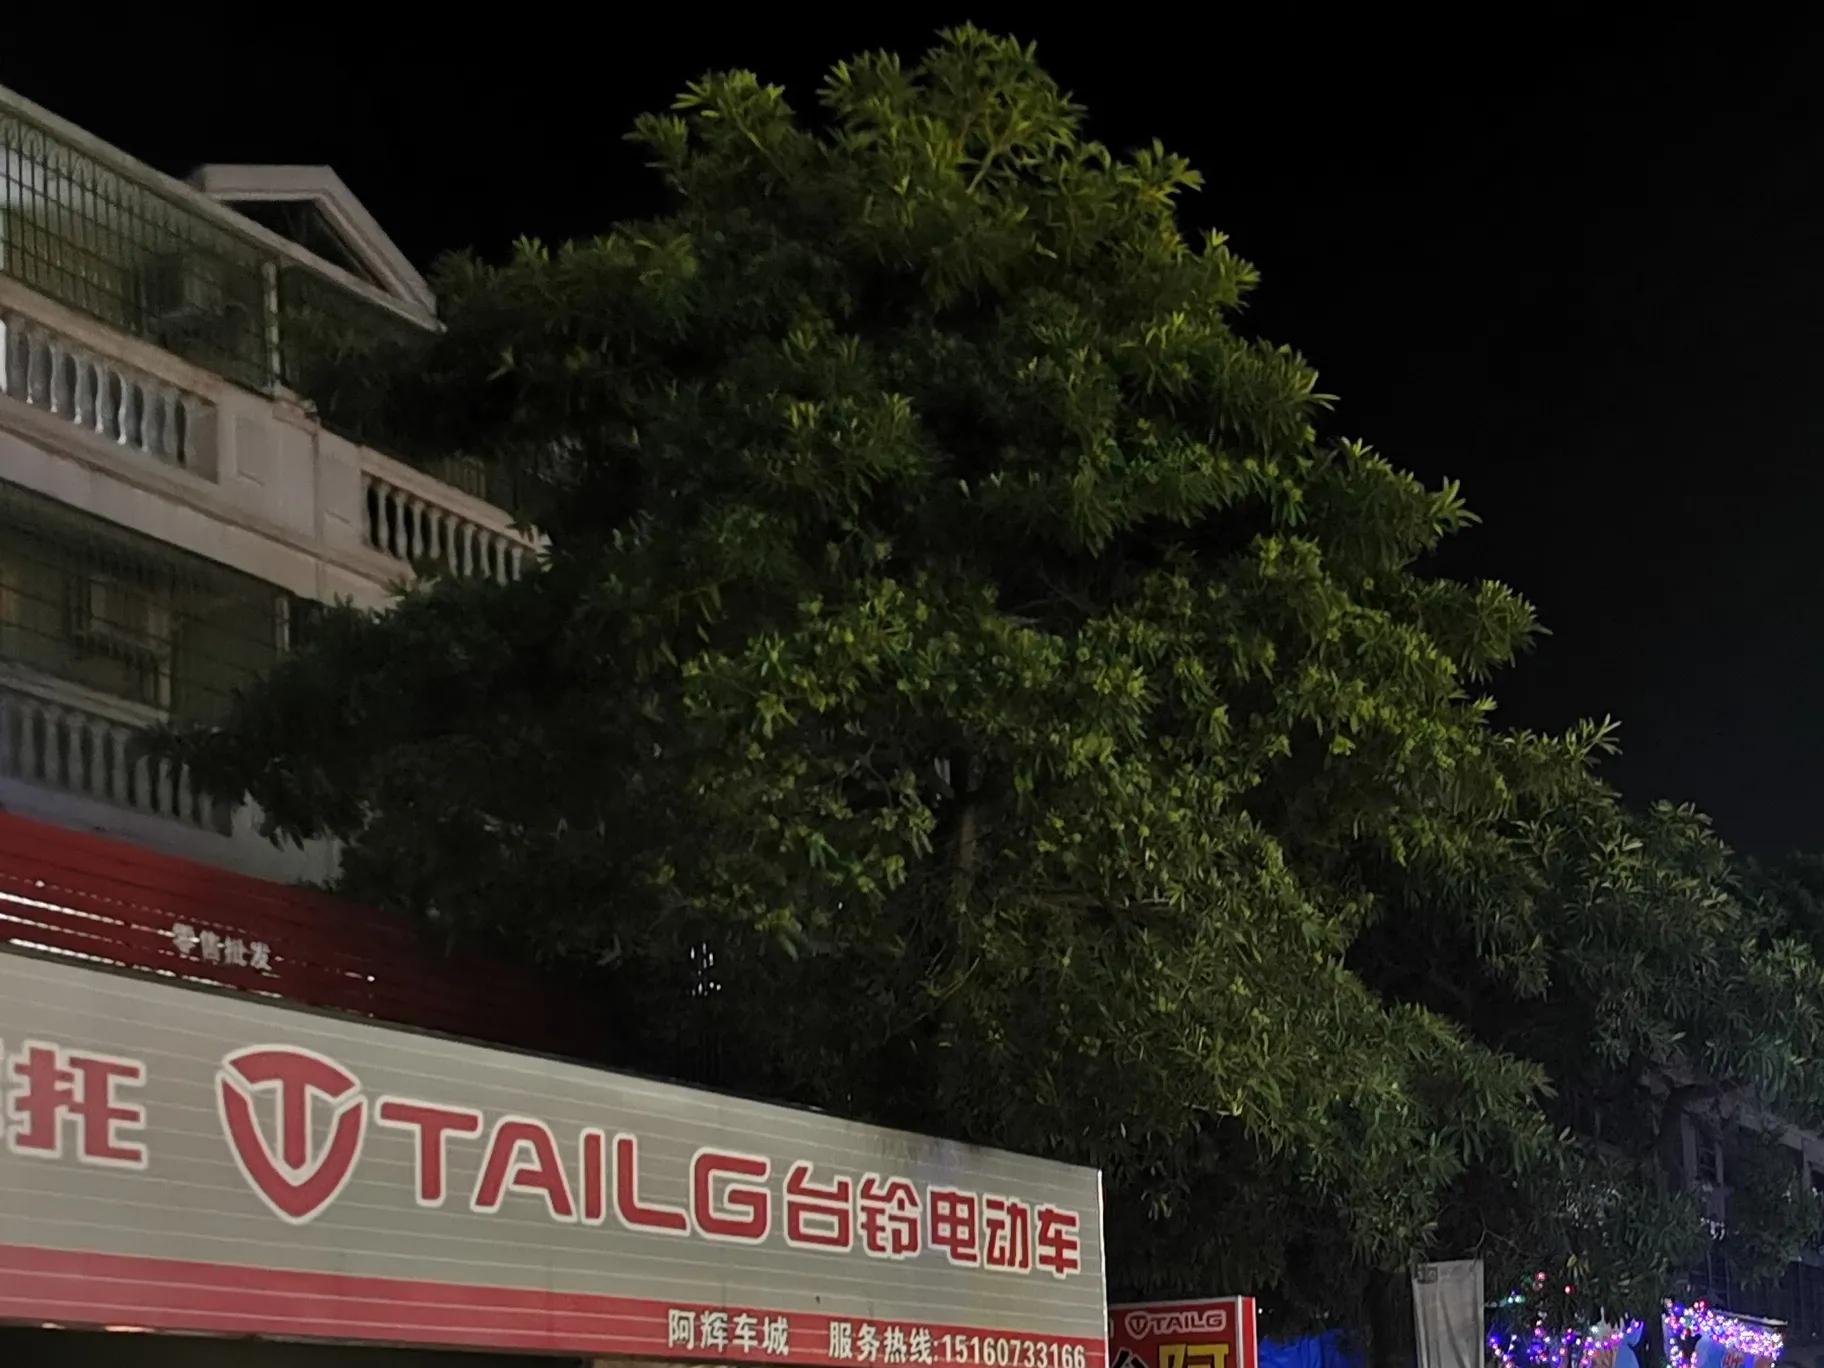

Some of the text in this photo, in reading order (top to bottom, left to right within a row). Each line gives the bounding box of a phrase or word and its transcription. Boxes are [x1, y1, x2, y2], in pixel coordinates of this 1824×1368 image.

[667, 1308, 790, 1356] 阿辉车城
[1151, 1310, 1226, 1334] TAILG
